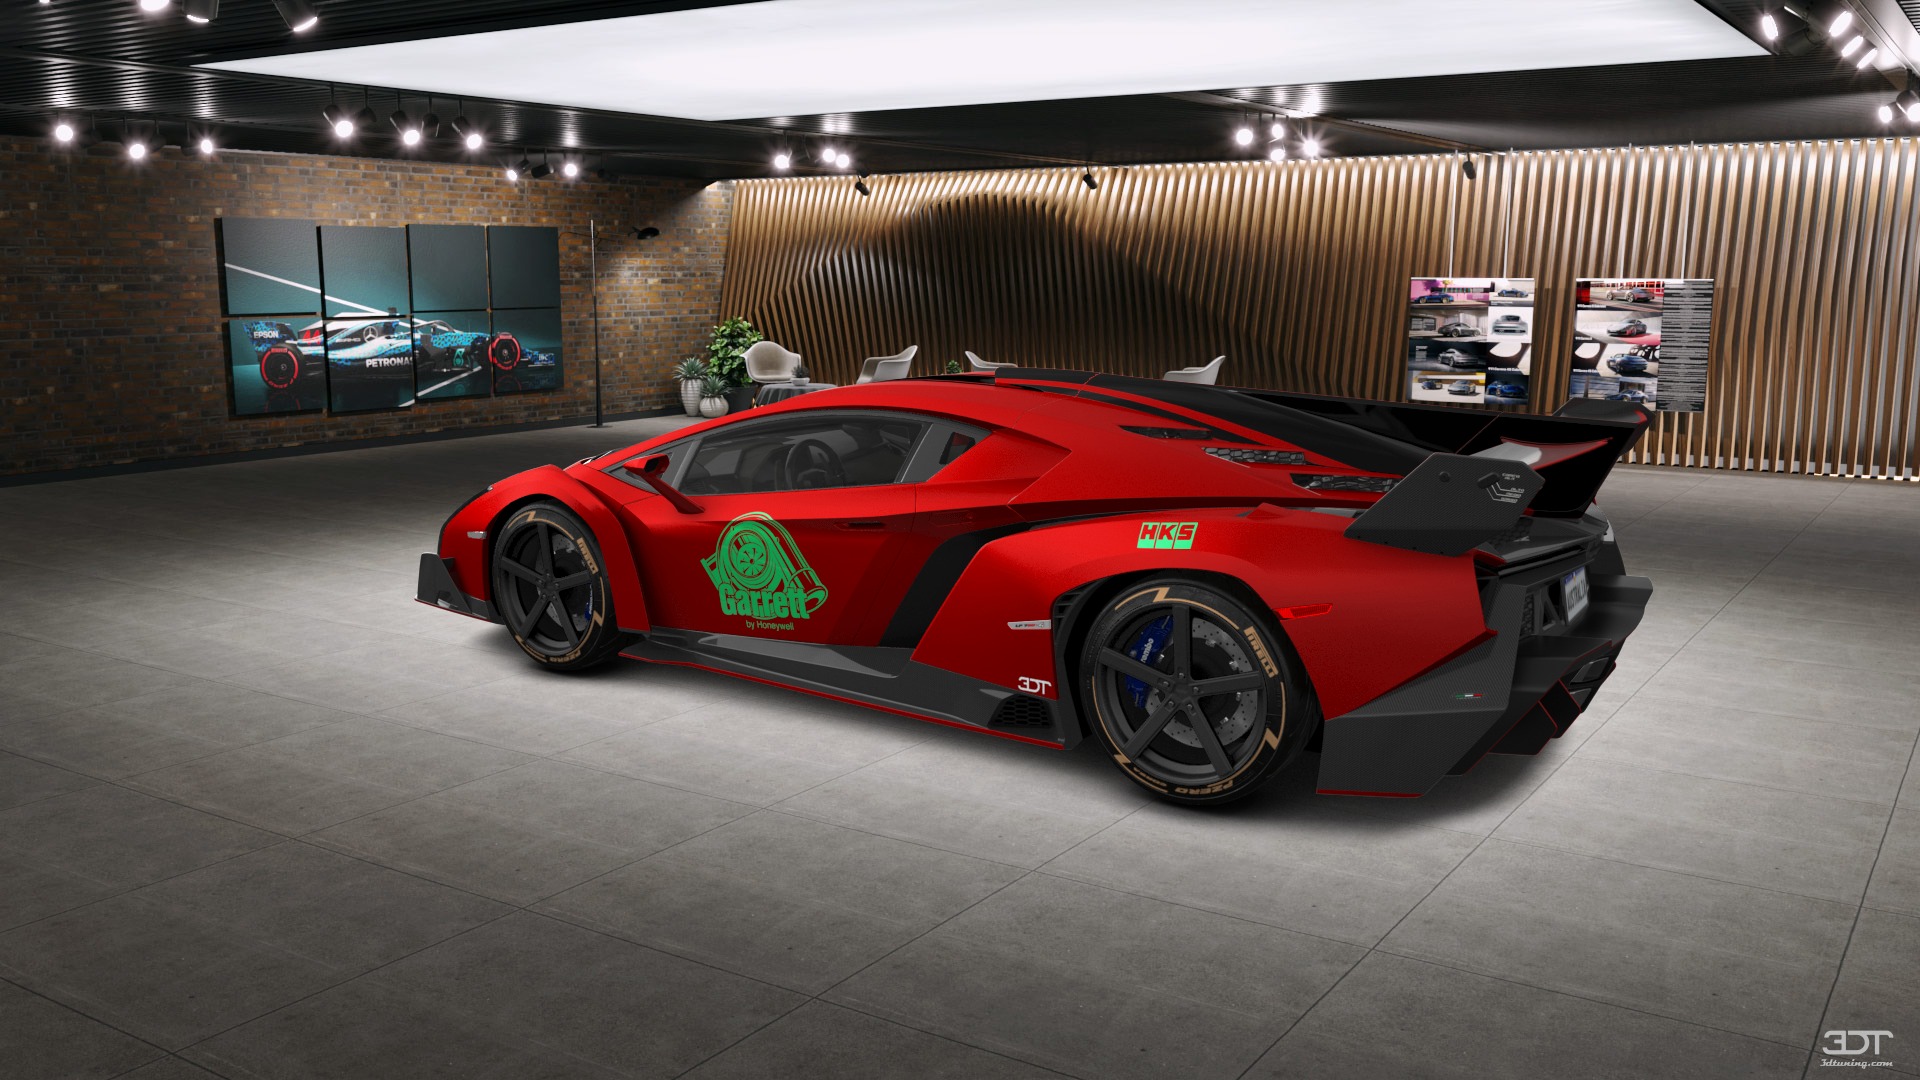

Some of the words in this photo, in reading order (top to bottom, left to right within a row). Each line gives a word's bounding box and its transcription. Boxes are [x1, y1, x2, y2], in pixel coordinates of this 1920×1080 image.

[253, 330, 279, 339] EPSON
[1139, 523, 1197, 543] HKS
[718, 582, 810, 619] Garrett
[745, 620, 755, 630] by
[756, 620, 795, 631] Honeywell
[1017, 676, 1052, 695] 3DT
